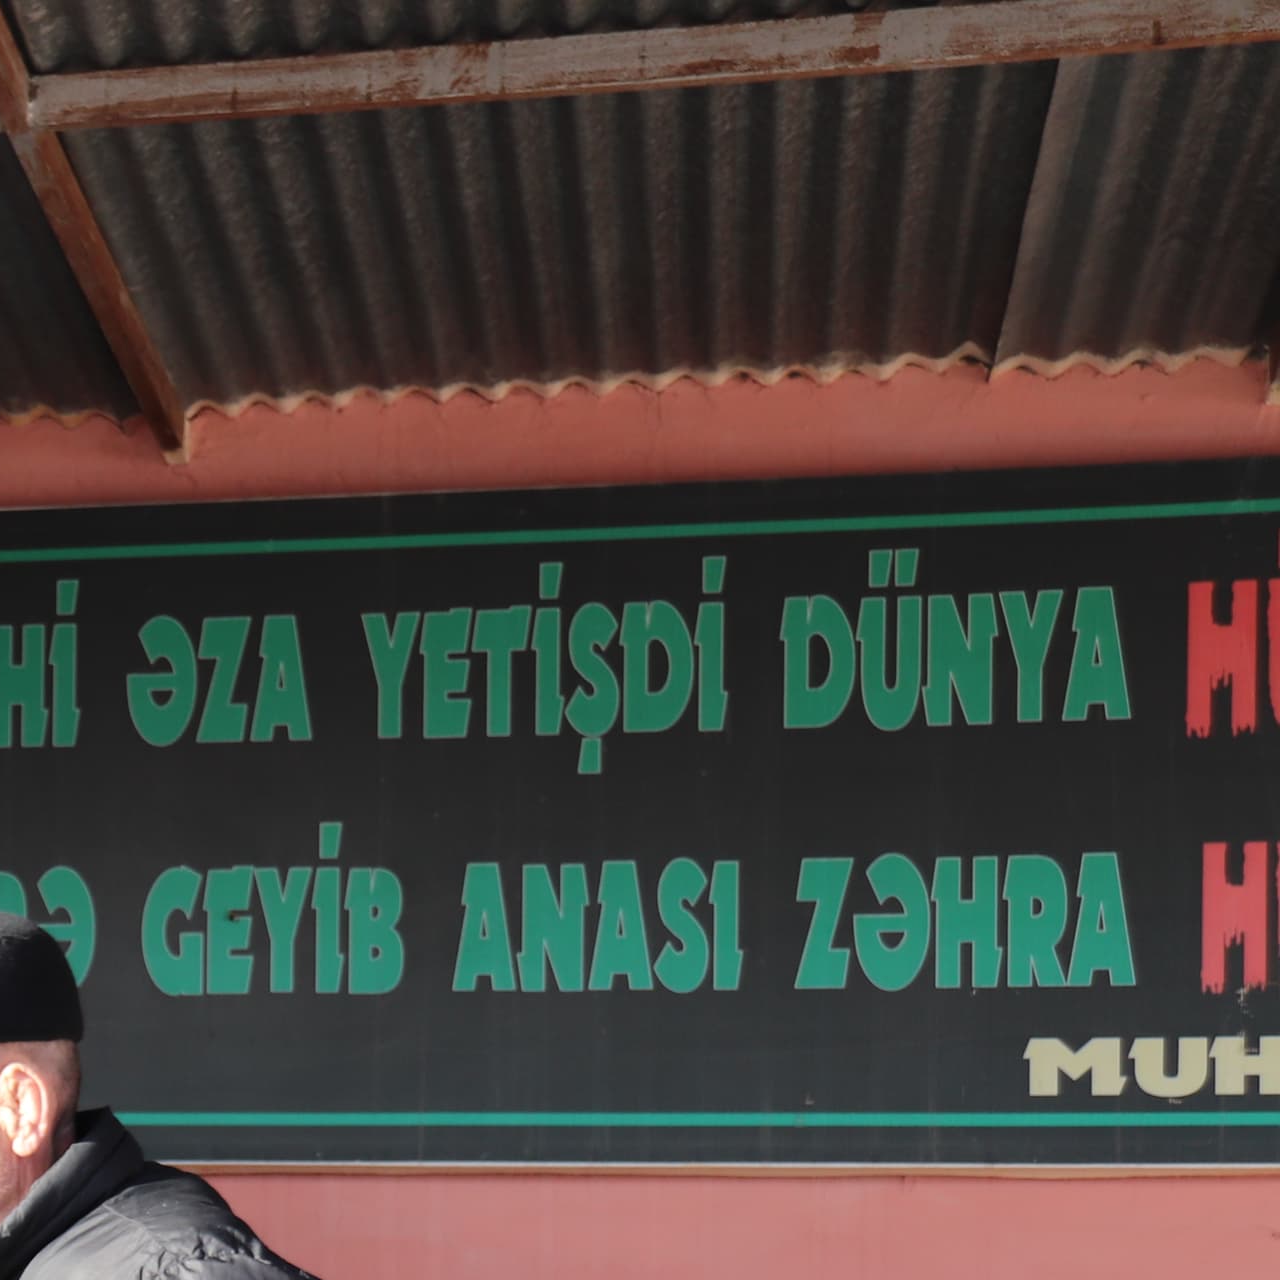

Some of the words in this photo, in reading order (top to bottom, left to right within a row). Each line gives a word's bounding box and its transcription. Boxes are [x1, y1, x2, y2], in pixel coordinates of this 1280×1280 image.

[126, 614, 313, 747] ƏZA
[361, 556, 729, 774] YETİŞDİ
[779, 547, 1132, 732] DÜNYA
[1185, 528, 1280, 739] H
[140, 821, 405, 997] GEYİB
[451, 856, 745, 993] ANASI
[793, 851, 1137, 992] ZƏHRA
